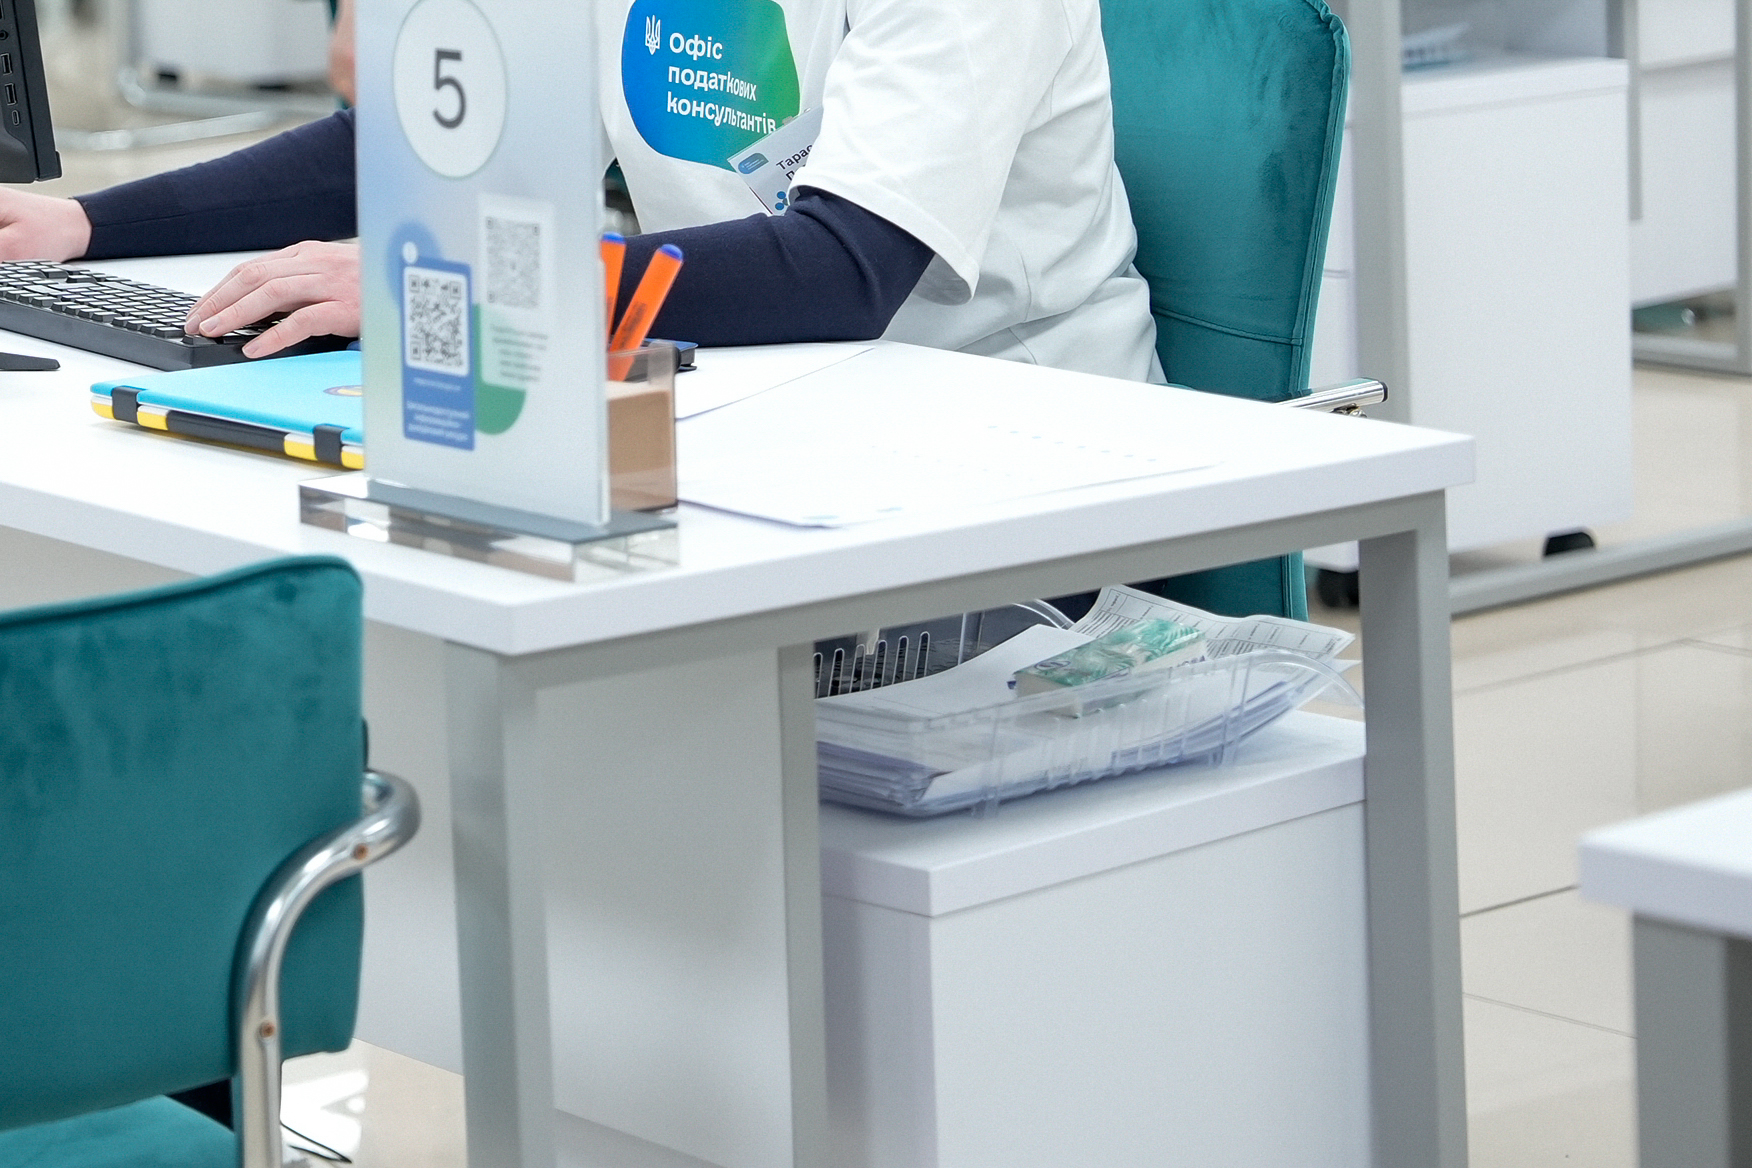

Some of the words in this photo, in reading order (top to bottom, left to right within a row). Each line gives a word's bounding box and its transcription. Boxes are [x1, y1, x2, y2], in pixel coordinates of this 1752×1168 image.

[669, 32, 723, 61] Офіс
[432, 47, 467, 130] 5
[668, 65, 757, 102] податкових
[666, 90, 777, 135] консультантів
